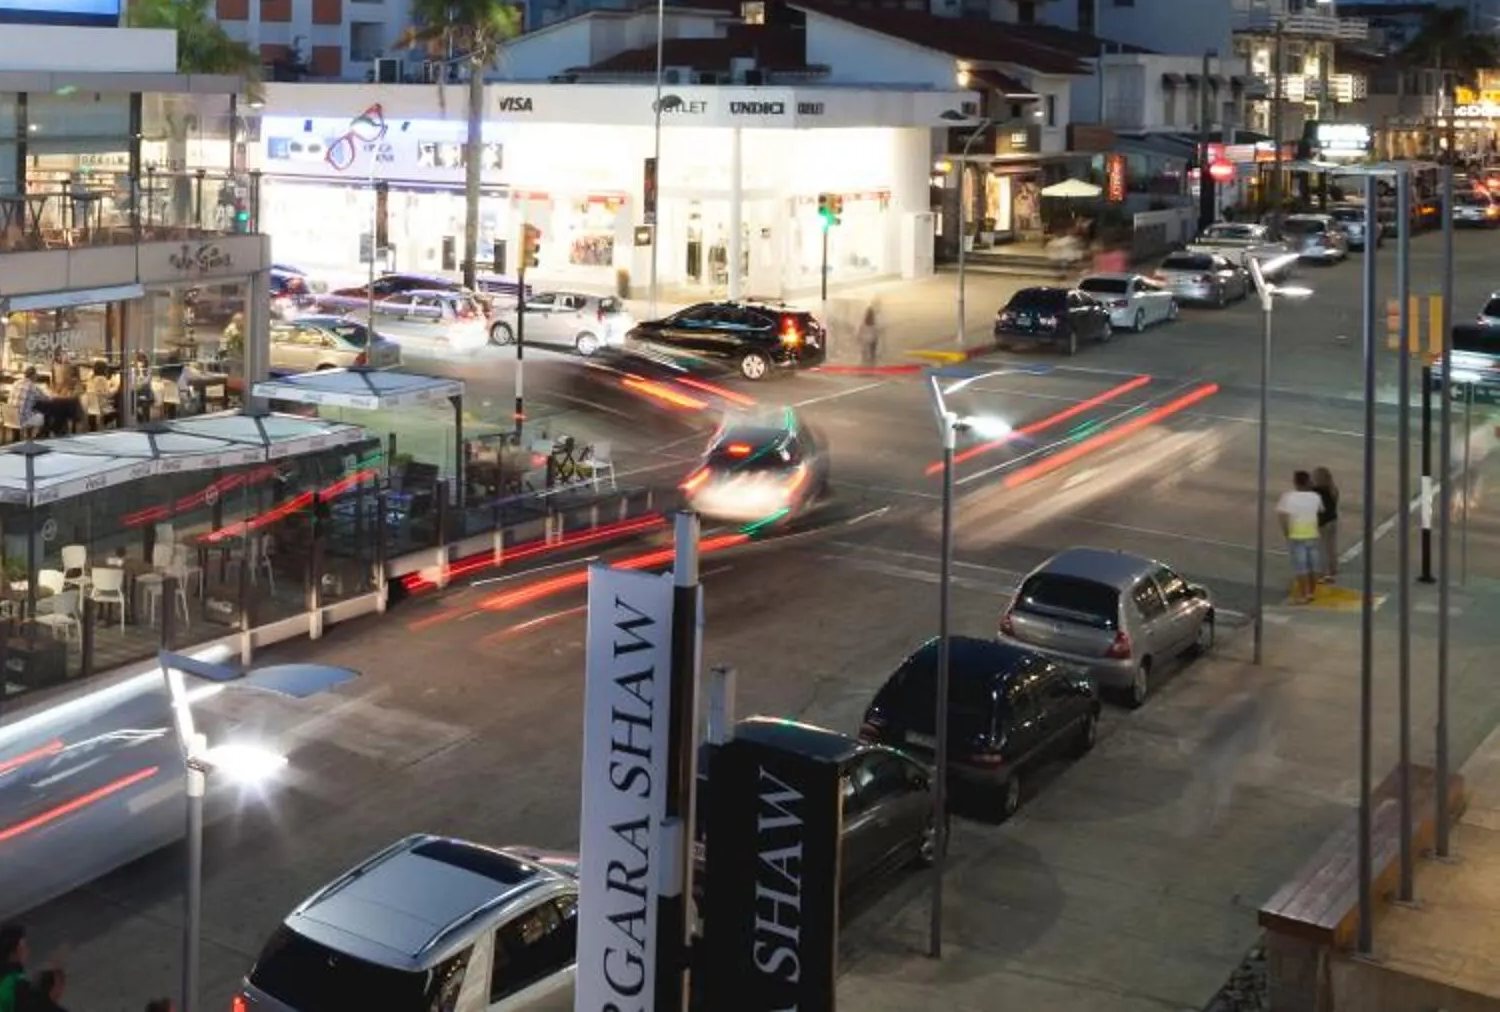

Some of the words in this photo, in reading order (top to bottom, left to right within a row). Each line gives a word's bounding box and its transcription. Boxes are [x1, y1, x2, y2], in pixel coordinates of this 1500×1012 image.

[500, 97, 533, 112] VISA
[609, 596, 656, 799] SHAW
[602, 815, 651, 1012] GARA
[753, 767, 804, 984] SHAW
